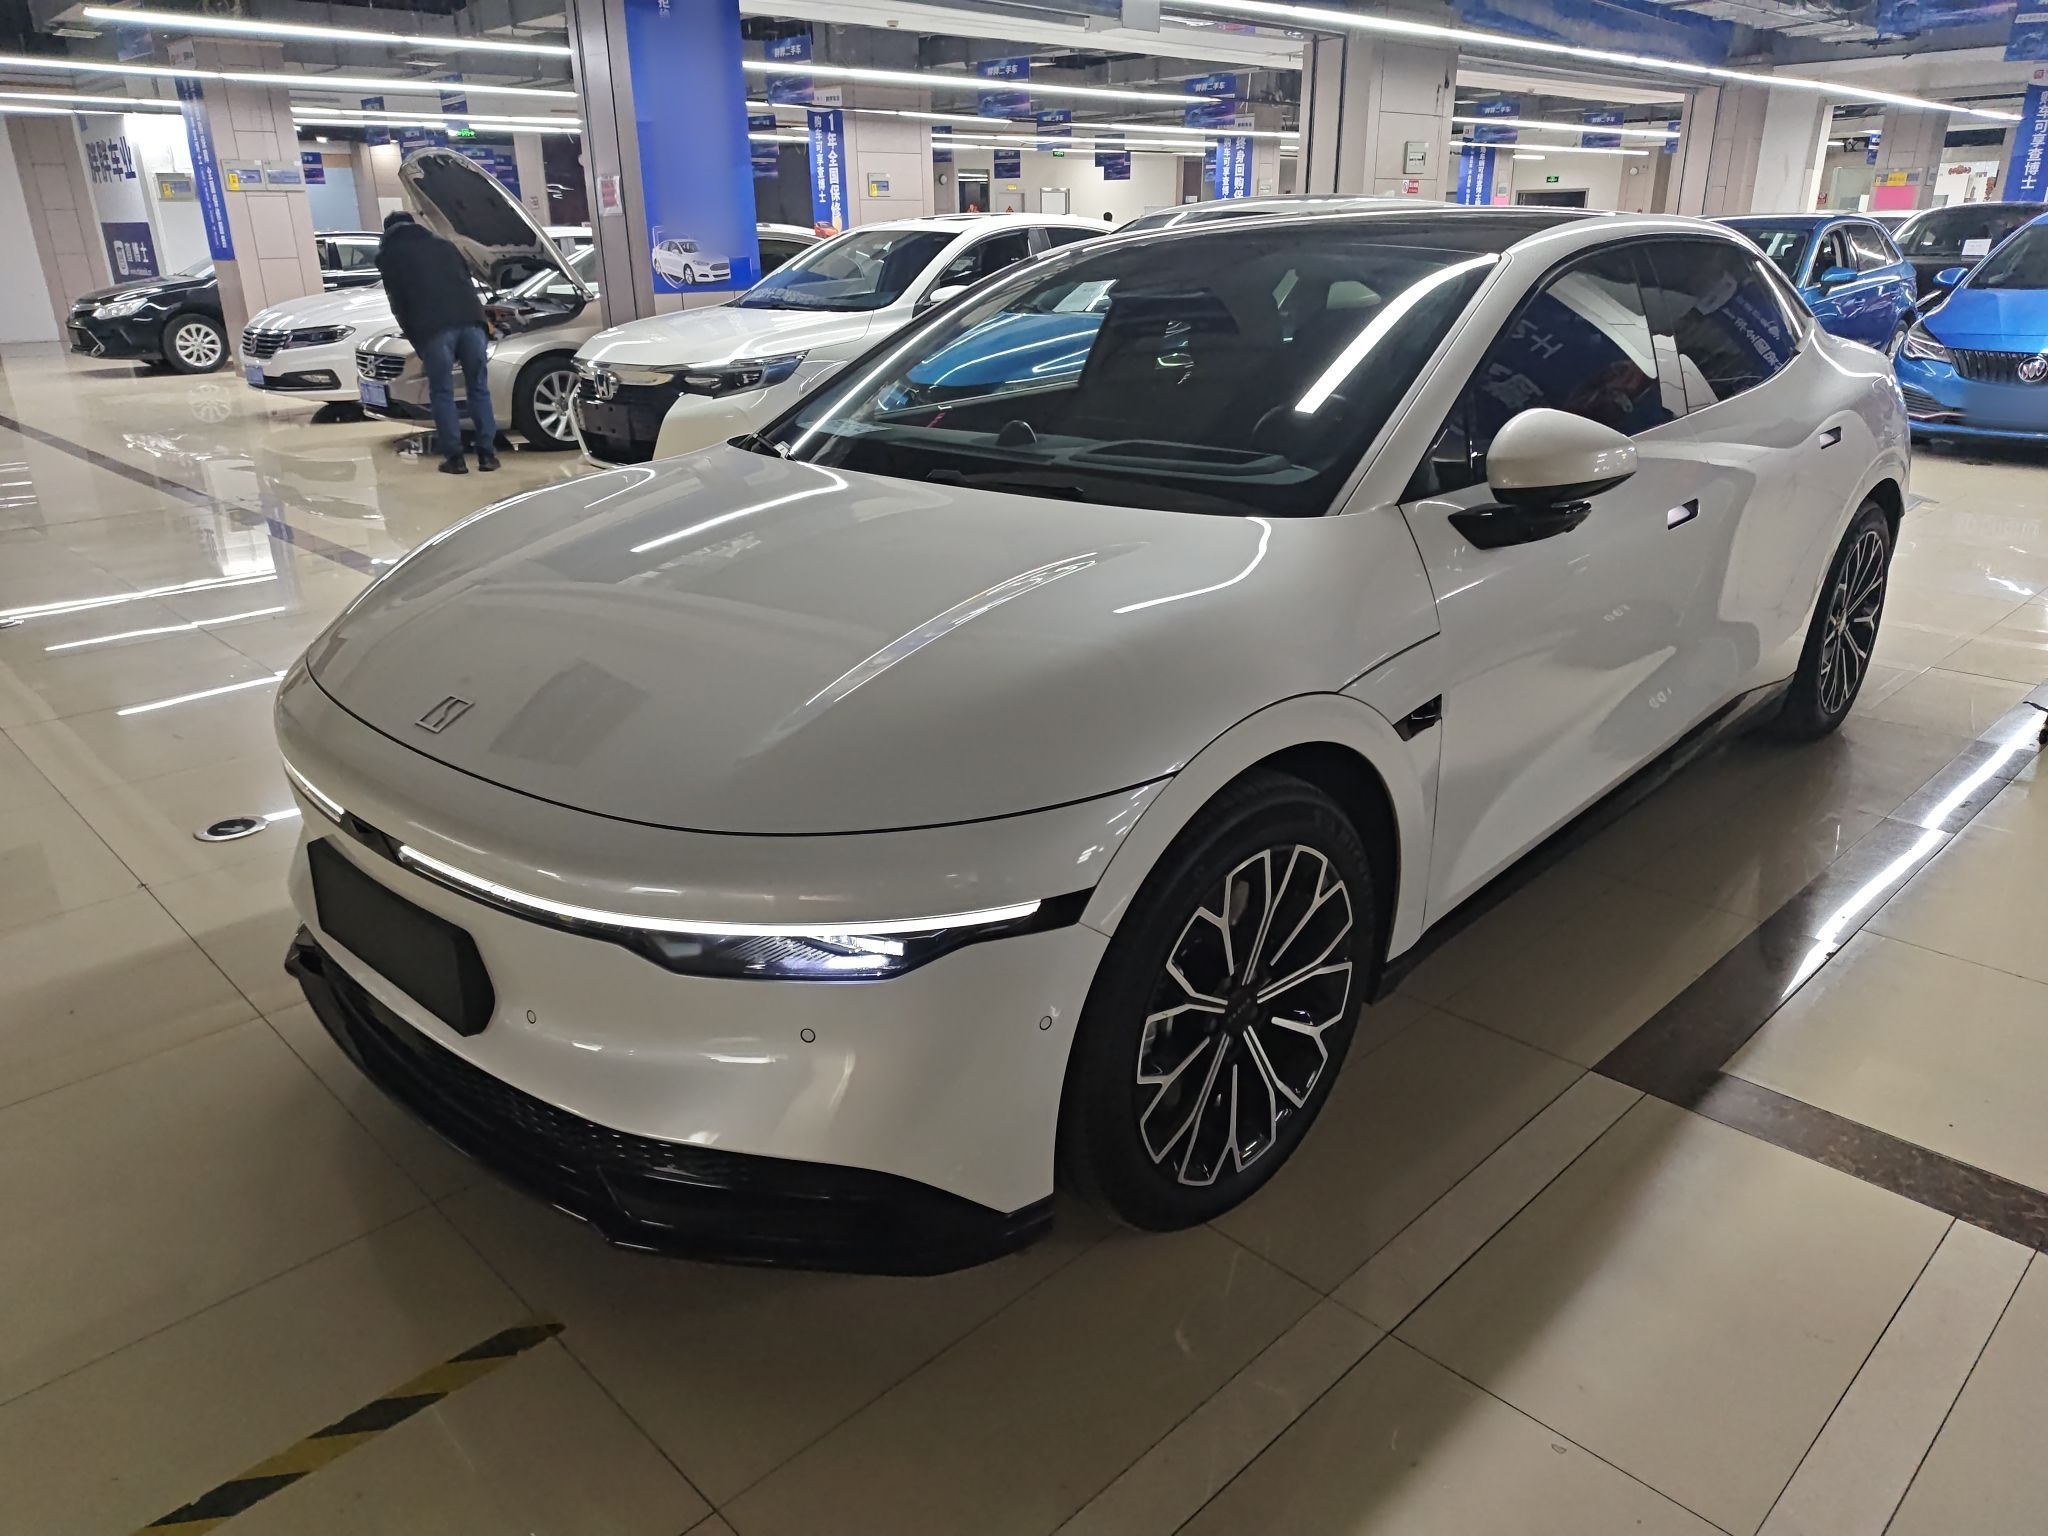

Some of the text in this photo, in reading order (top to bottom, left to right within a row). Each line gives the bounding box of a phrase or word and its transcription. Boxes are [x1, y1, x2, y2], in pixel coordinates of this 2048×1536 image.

[814, 115, 827, 203] 购车可享查博士
[827, 113, 842, 218] 1年全国保修
